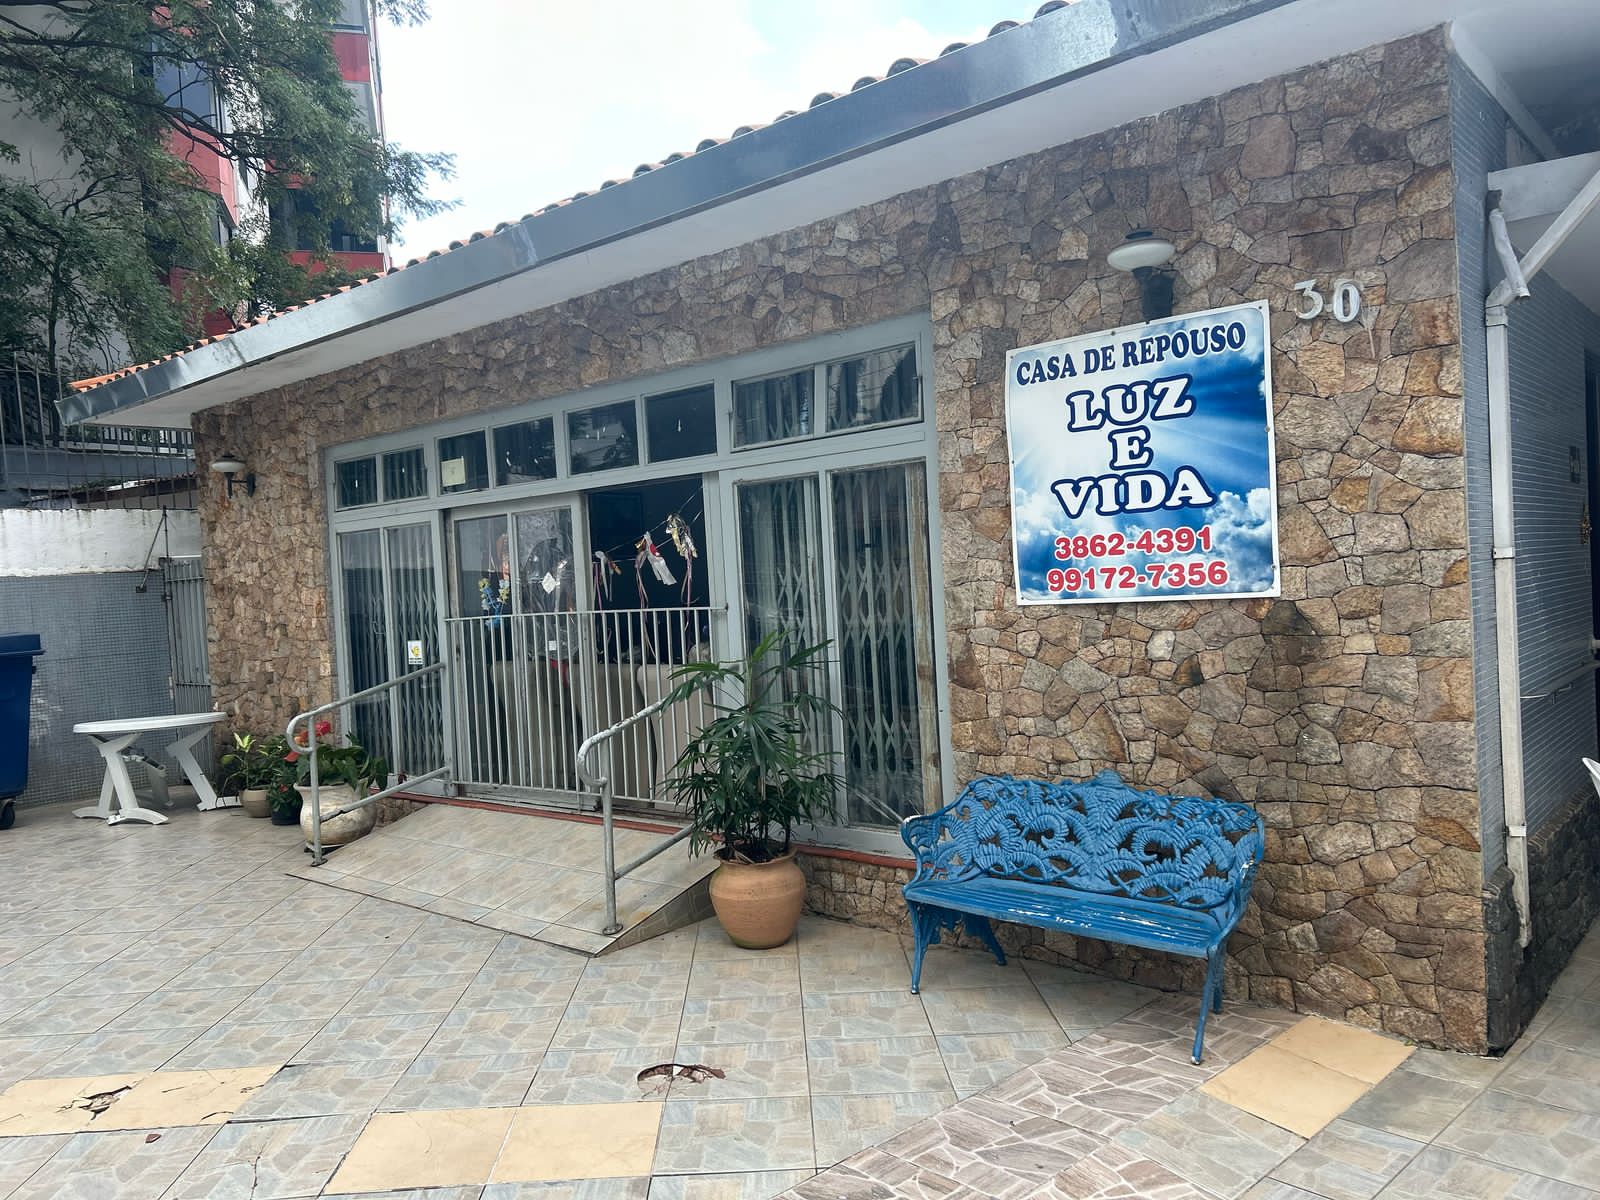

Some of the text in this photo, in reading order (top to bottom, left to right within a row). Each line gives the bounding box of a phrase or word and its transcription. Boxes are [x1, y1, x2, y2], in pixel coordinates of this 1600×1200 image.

[1293, 279, 1361, 323] 30
[1017, 321, 1246, 385] CASA DE REPOUSO
[1067, 375, 1194, 432] LUZ
[1108, 425, 1153, 470] E
[1052, 466, 1214, 518] VIDA
[1054, 526, 1213, 560] 3862-4391
[1047, 560, 1228, 592] 99172-7356
